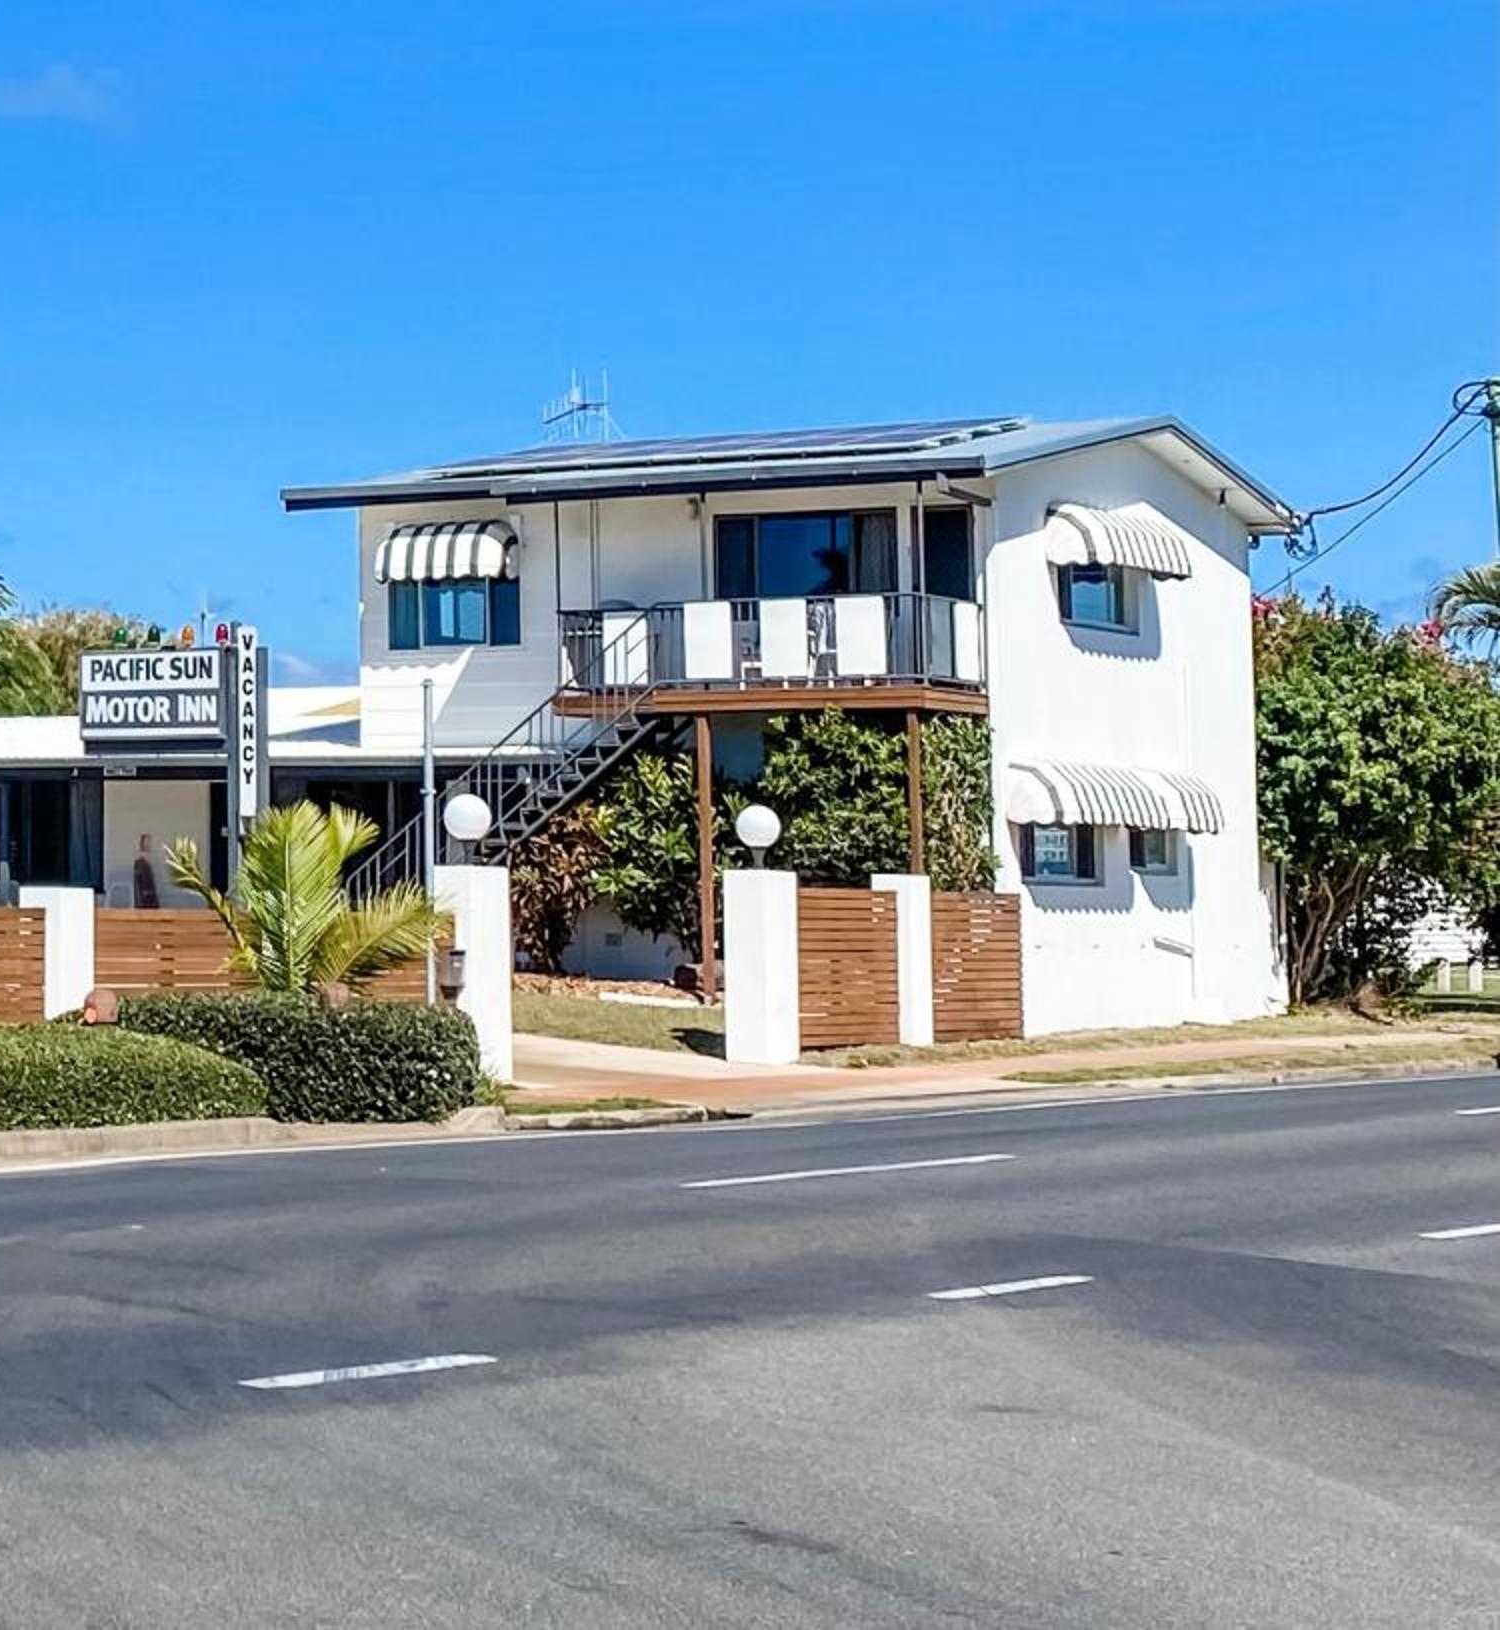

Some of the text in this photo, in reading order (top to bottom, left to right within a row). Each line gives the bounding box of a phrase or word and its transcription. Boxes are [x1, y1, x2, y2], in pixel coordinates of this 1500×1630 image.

[90, 656, 213, 682] PACIFIC SUN
[85, 694, 217, 723] MOTOR INN
[242, 634, 254, 784] VACANCY
